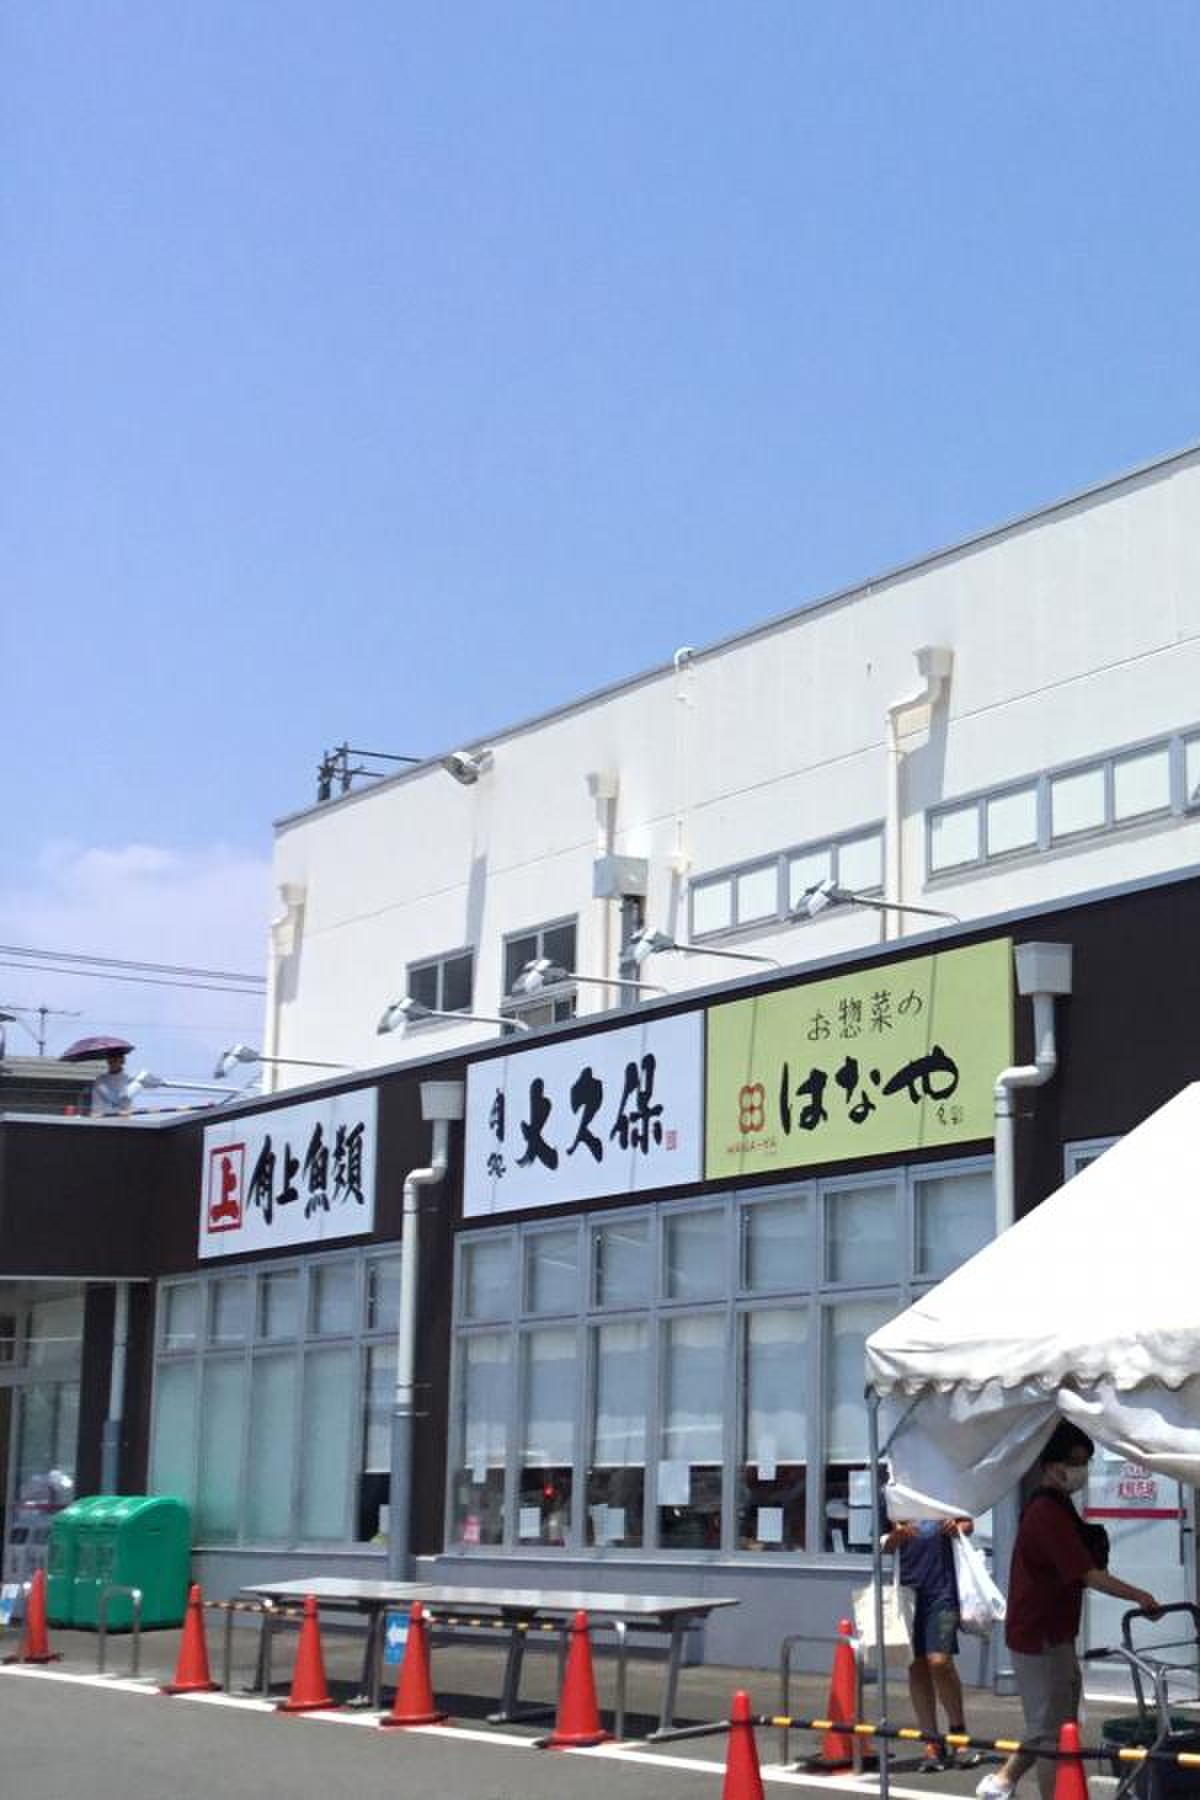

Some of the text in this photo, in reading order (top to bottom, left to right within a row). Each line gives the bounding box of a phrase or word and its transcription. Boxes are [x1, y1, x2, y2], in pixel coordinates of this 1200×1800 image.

[806, 988, 924, 1041] お惣菜の
[515, 1052, 664, 1171] 大久保
[779, 1044, 960, 1137] はなや
[246, 1121, 366, 1226] 角上魚類
